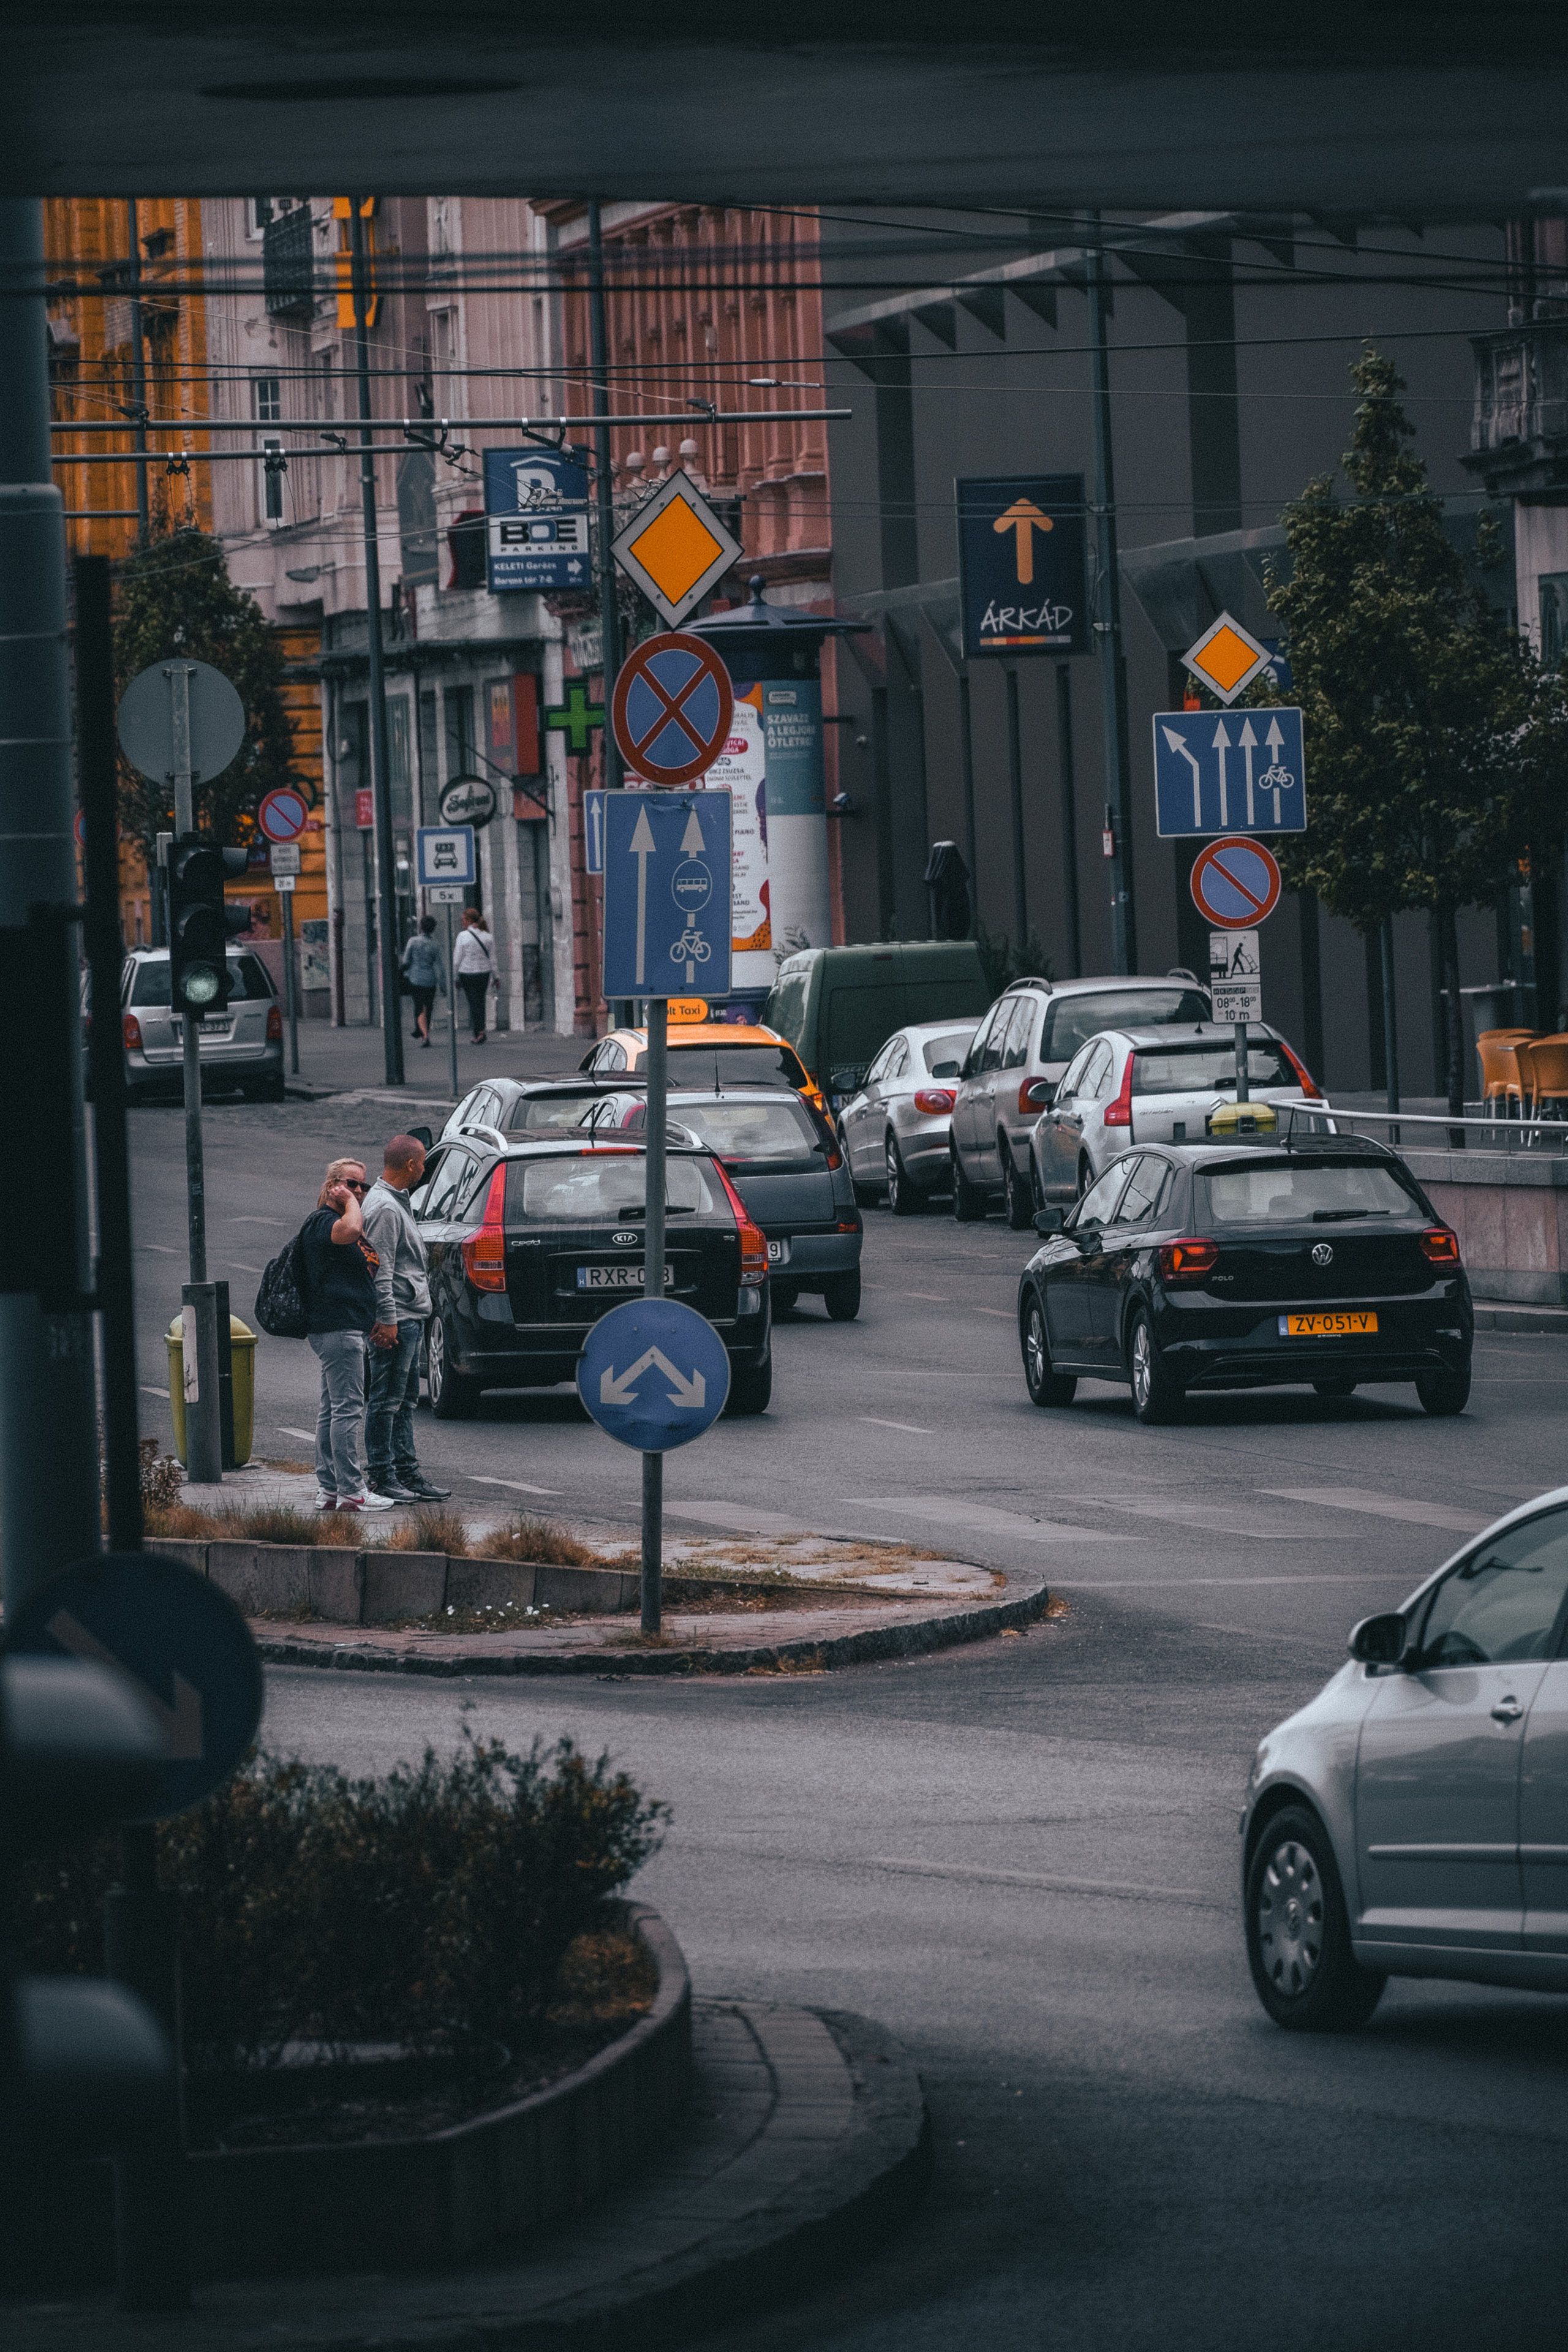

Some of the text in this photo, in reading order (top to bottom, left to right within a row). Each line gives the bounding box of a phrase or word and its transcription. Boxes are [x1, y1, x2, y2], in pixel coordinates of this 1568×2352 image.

[494, 562, 524, 571] KELETI
[981, 598, 1072, 633] ÁRKÁD
[679, 1005, 700, 1014] Taxi
[1224, 1009, 1250, 1020] 10 m
[1295, 1314, 1368, 1332] ZV-051-V
